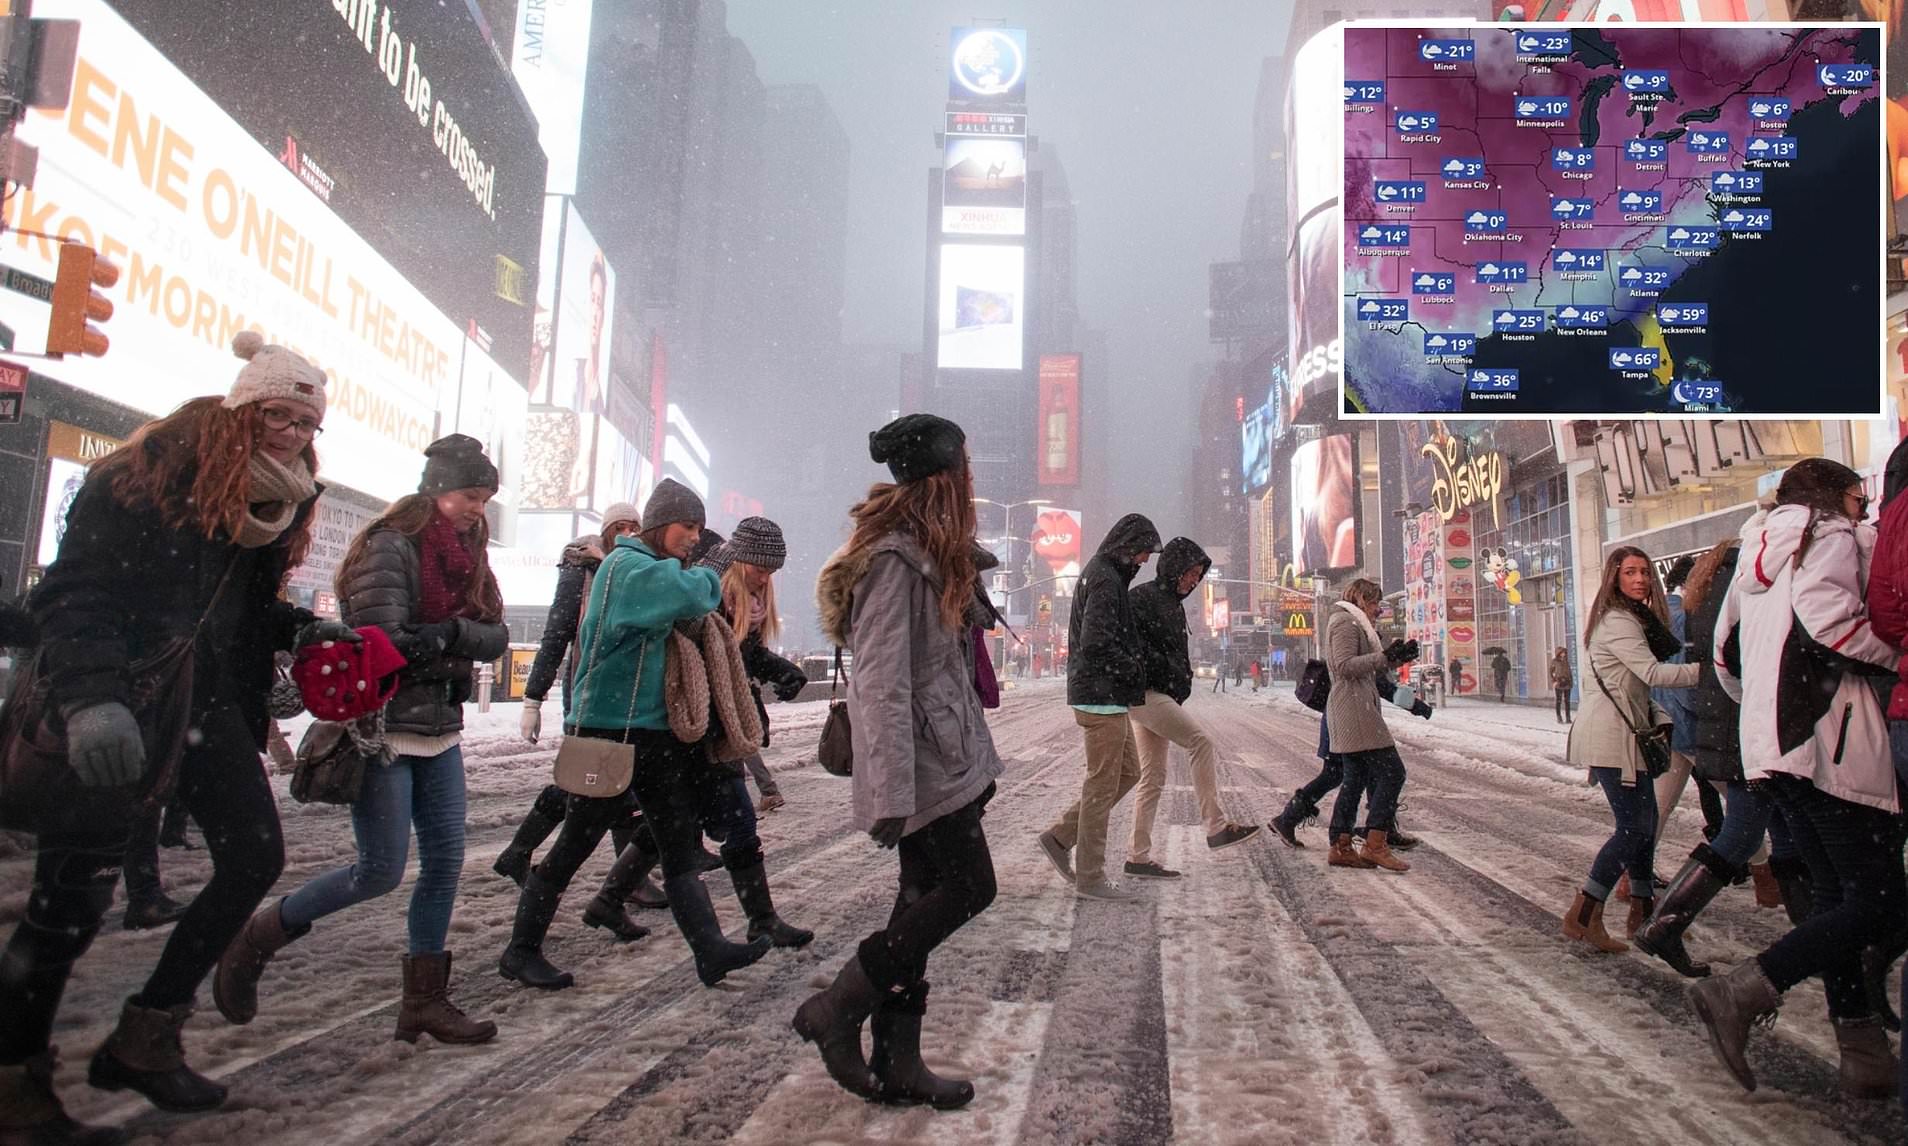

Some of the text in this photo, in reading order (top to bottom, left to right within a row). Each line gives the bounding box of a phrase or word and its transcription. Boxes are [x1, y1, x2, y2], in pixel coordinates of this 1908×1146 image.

[333, 0, 495, 221] nt to be crossed.
[956, 123, 1014, 133] GALLERY
[302, 152, 335, 191] MARRIOTT
[54, 56, 449, 388] ENE O'NEILL THEATRE
[0, 367, 15, 384] AY
